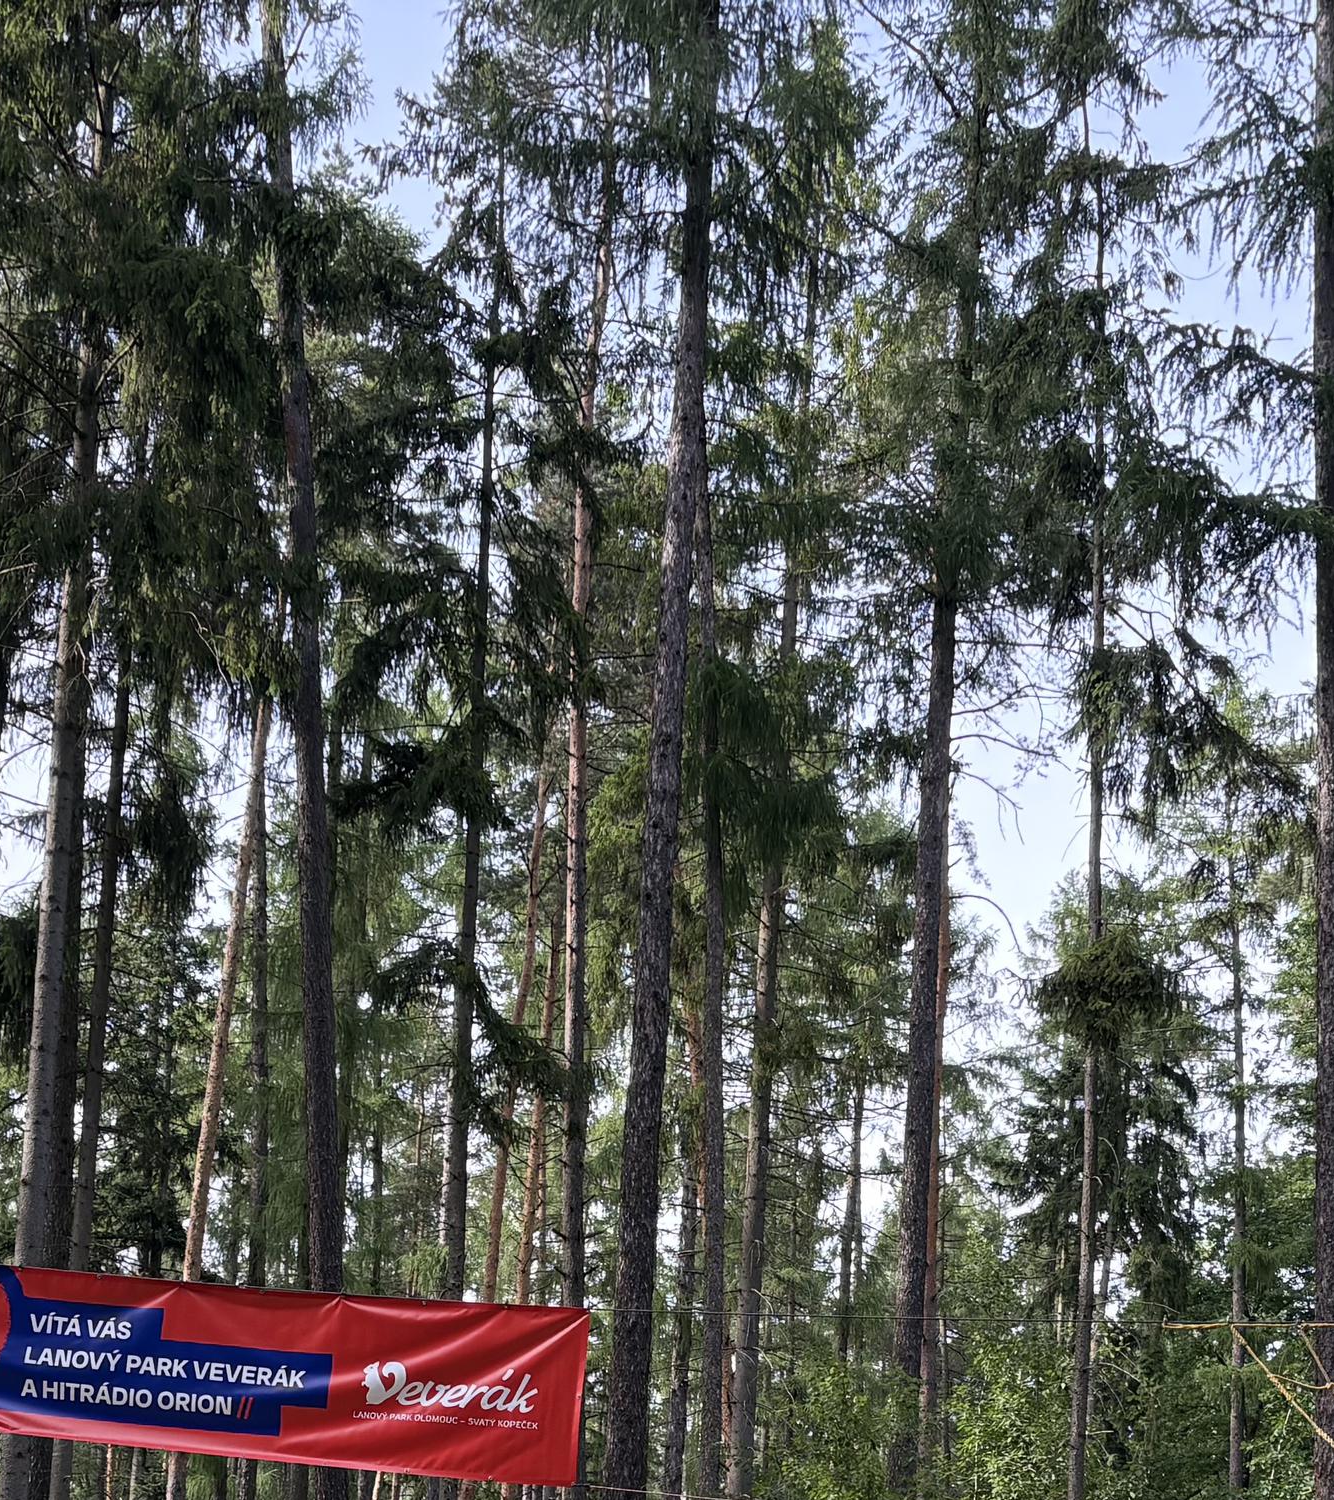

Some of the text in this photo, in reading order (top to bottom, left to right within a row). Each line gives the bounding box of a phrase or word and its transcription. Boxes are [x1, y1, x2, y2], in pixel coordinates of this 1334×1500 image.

[30, 1312, 132, 1340] VÍTÁ VÁS
[23, 1346, 306, 1388] LANOVÝ PARK VEVERÁK
[21, 1379, 233, 1416] A HITRÁDIO ORION
[361, 1361, 539, 1414] Veverák
[352, 1410, 388, 1421] LANOVÝ
[389, 1413, 413, 1422] PARK
[414, 1414, 459, 1425] OLOMOUC
[468, 1417, 496, 1427] SVATÝ
[497, 1418, 539, 1430] KOPEČEK
